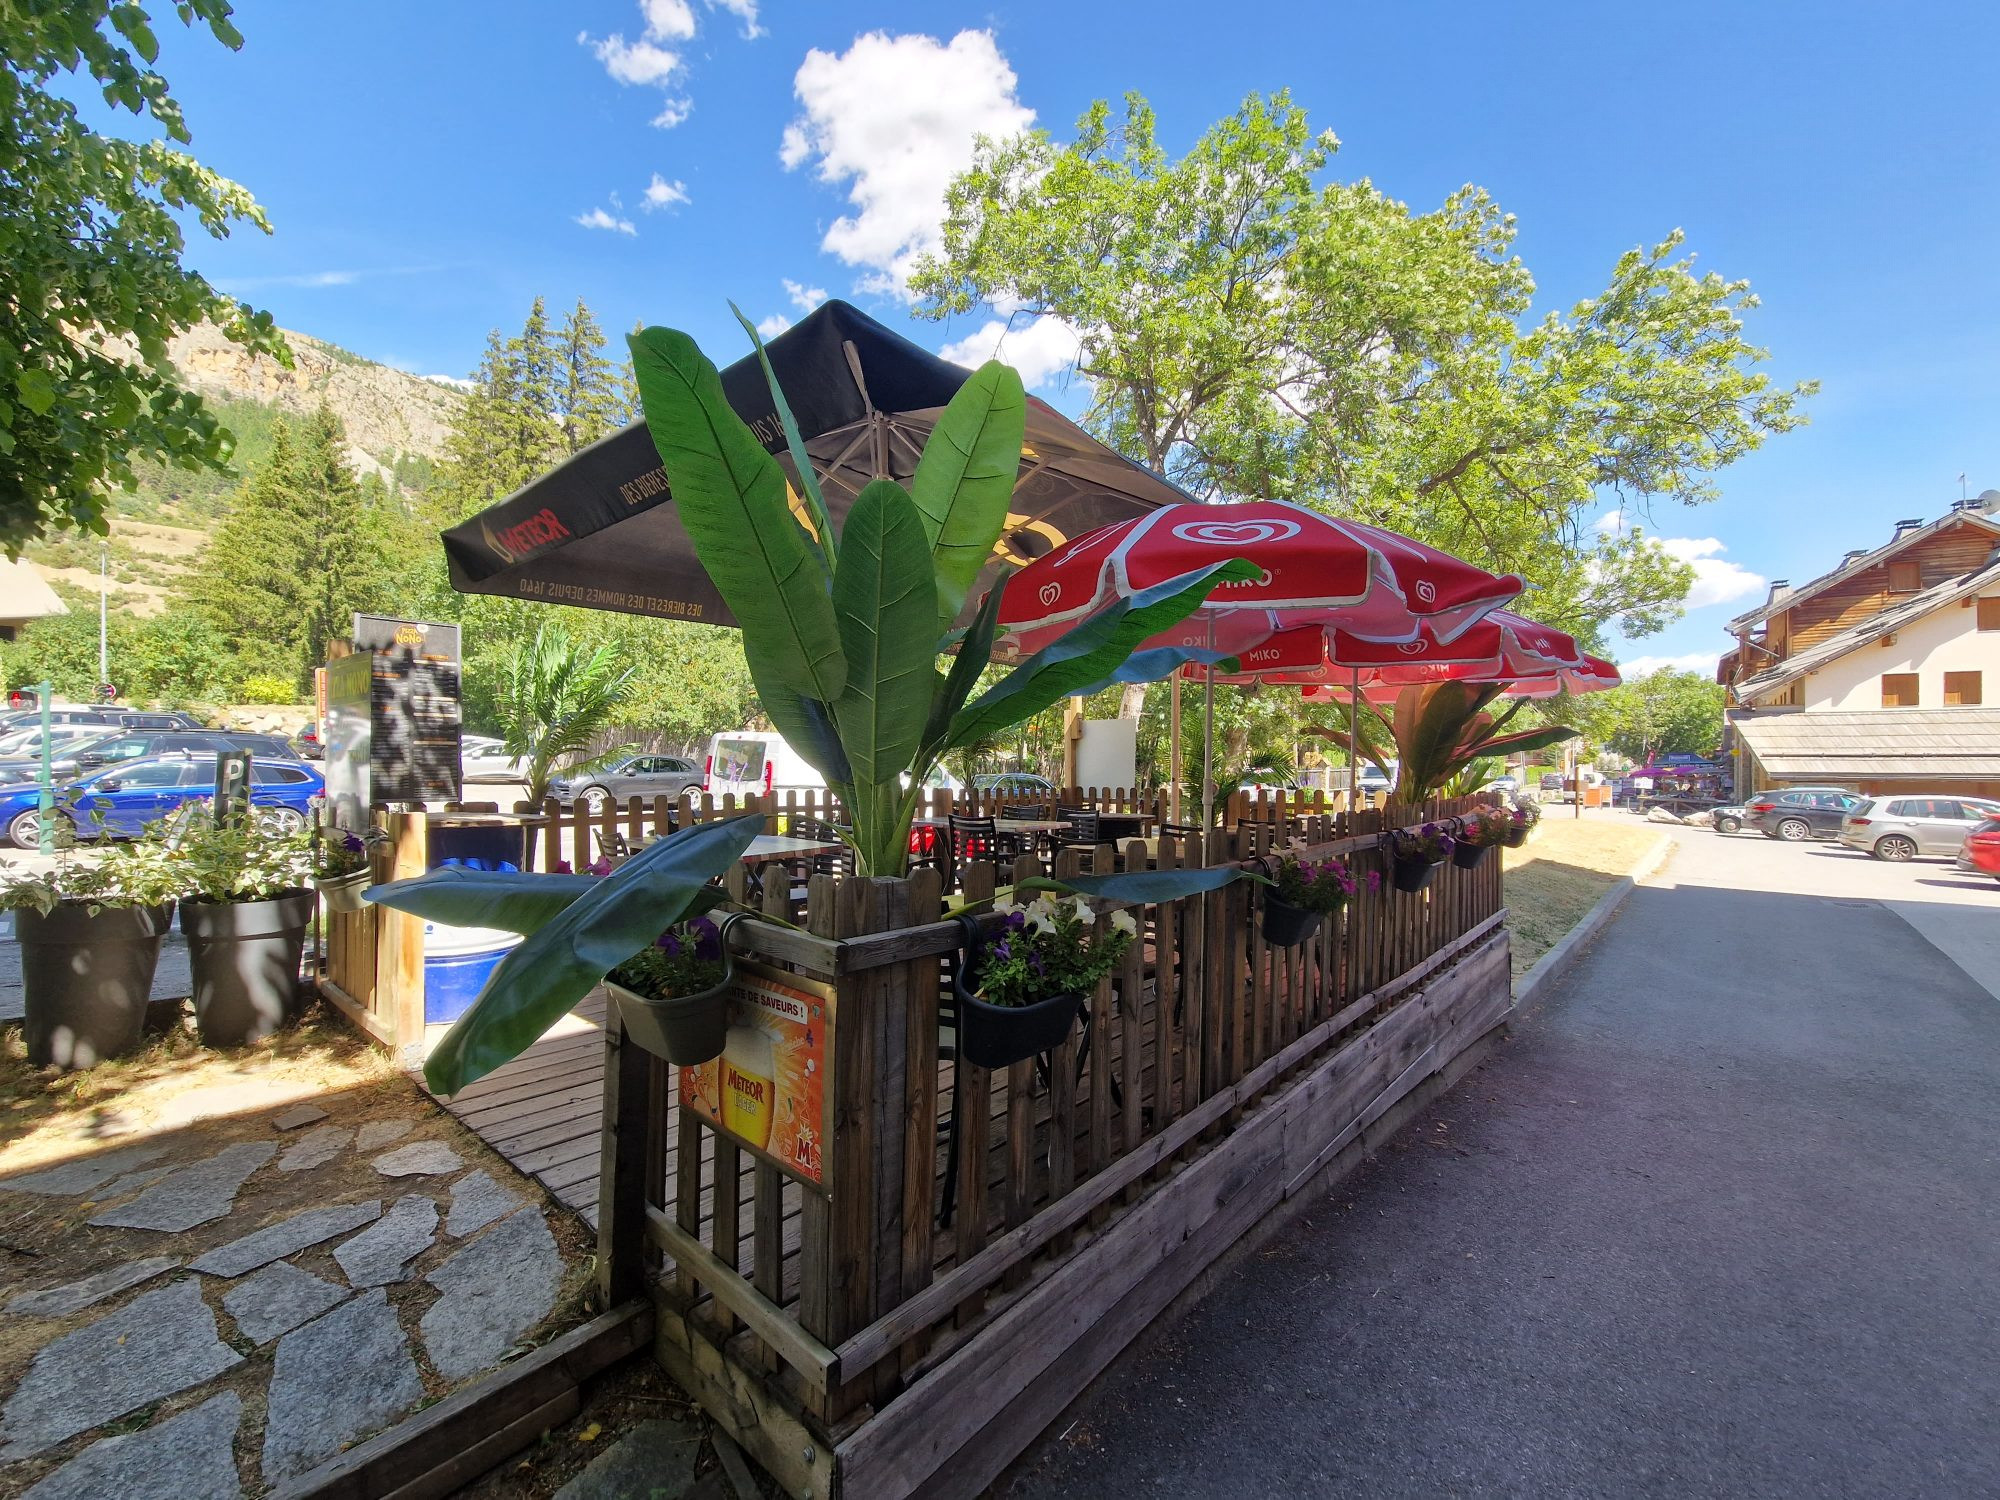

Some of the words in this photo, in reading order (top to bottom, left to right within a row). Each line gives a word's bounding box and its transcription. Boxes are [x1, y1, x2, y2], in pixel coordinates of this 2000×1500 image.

[497, 508, 570, 559] METEOR
[1249, 648, 1280, 662] MIKO
[760, 994, 799, 1017] SAVEURS
[728, 1067, 764, 1104] METEOR
